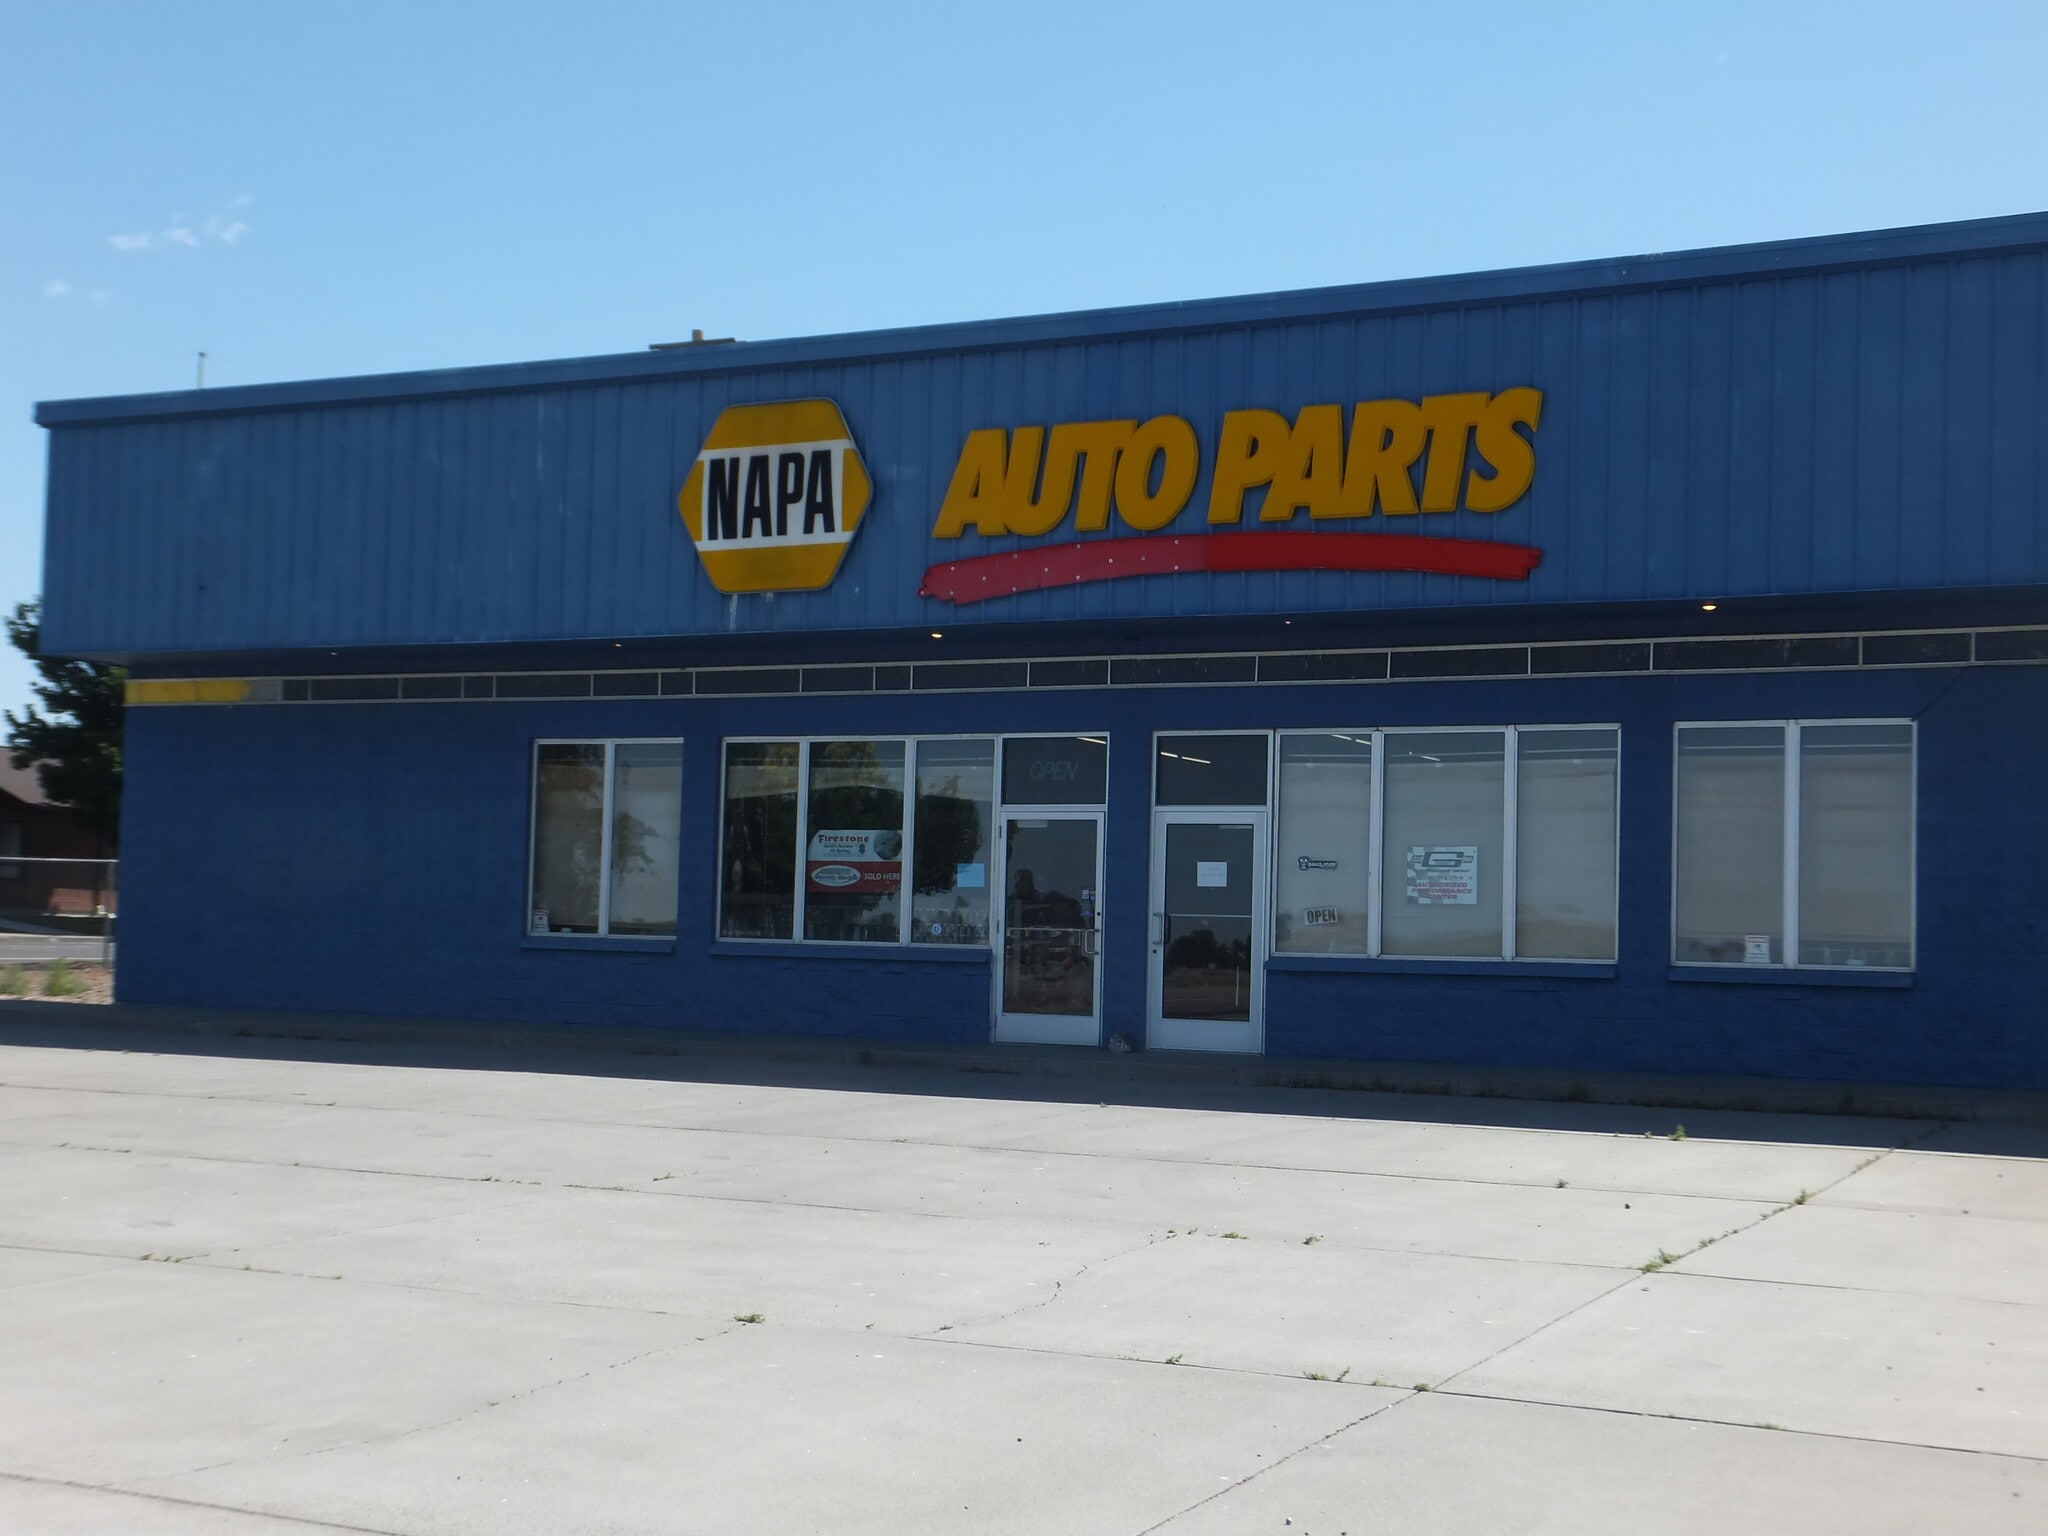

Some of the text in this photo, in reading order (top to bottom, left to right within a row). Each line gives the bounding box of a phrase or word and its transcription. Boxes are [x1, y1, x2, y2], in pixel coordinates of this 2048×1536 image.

[932, 387, 1544, 539] AUTO PARTS
[706, 449, 835, 541] NAPA
[1030, 760, 1079, 781] OPEN
[818, 834, 870, 843] Firestone
[864, 872, 881, 880] SOLD
[1306, 908, 1337, 924] OPEN
